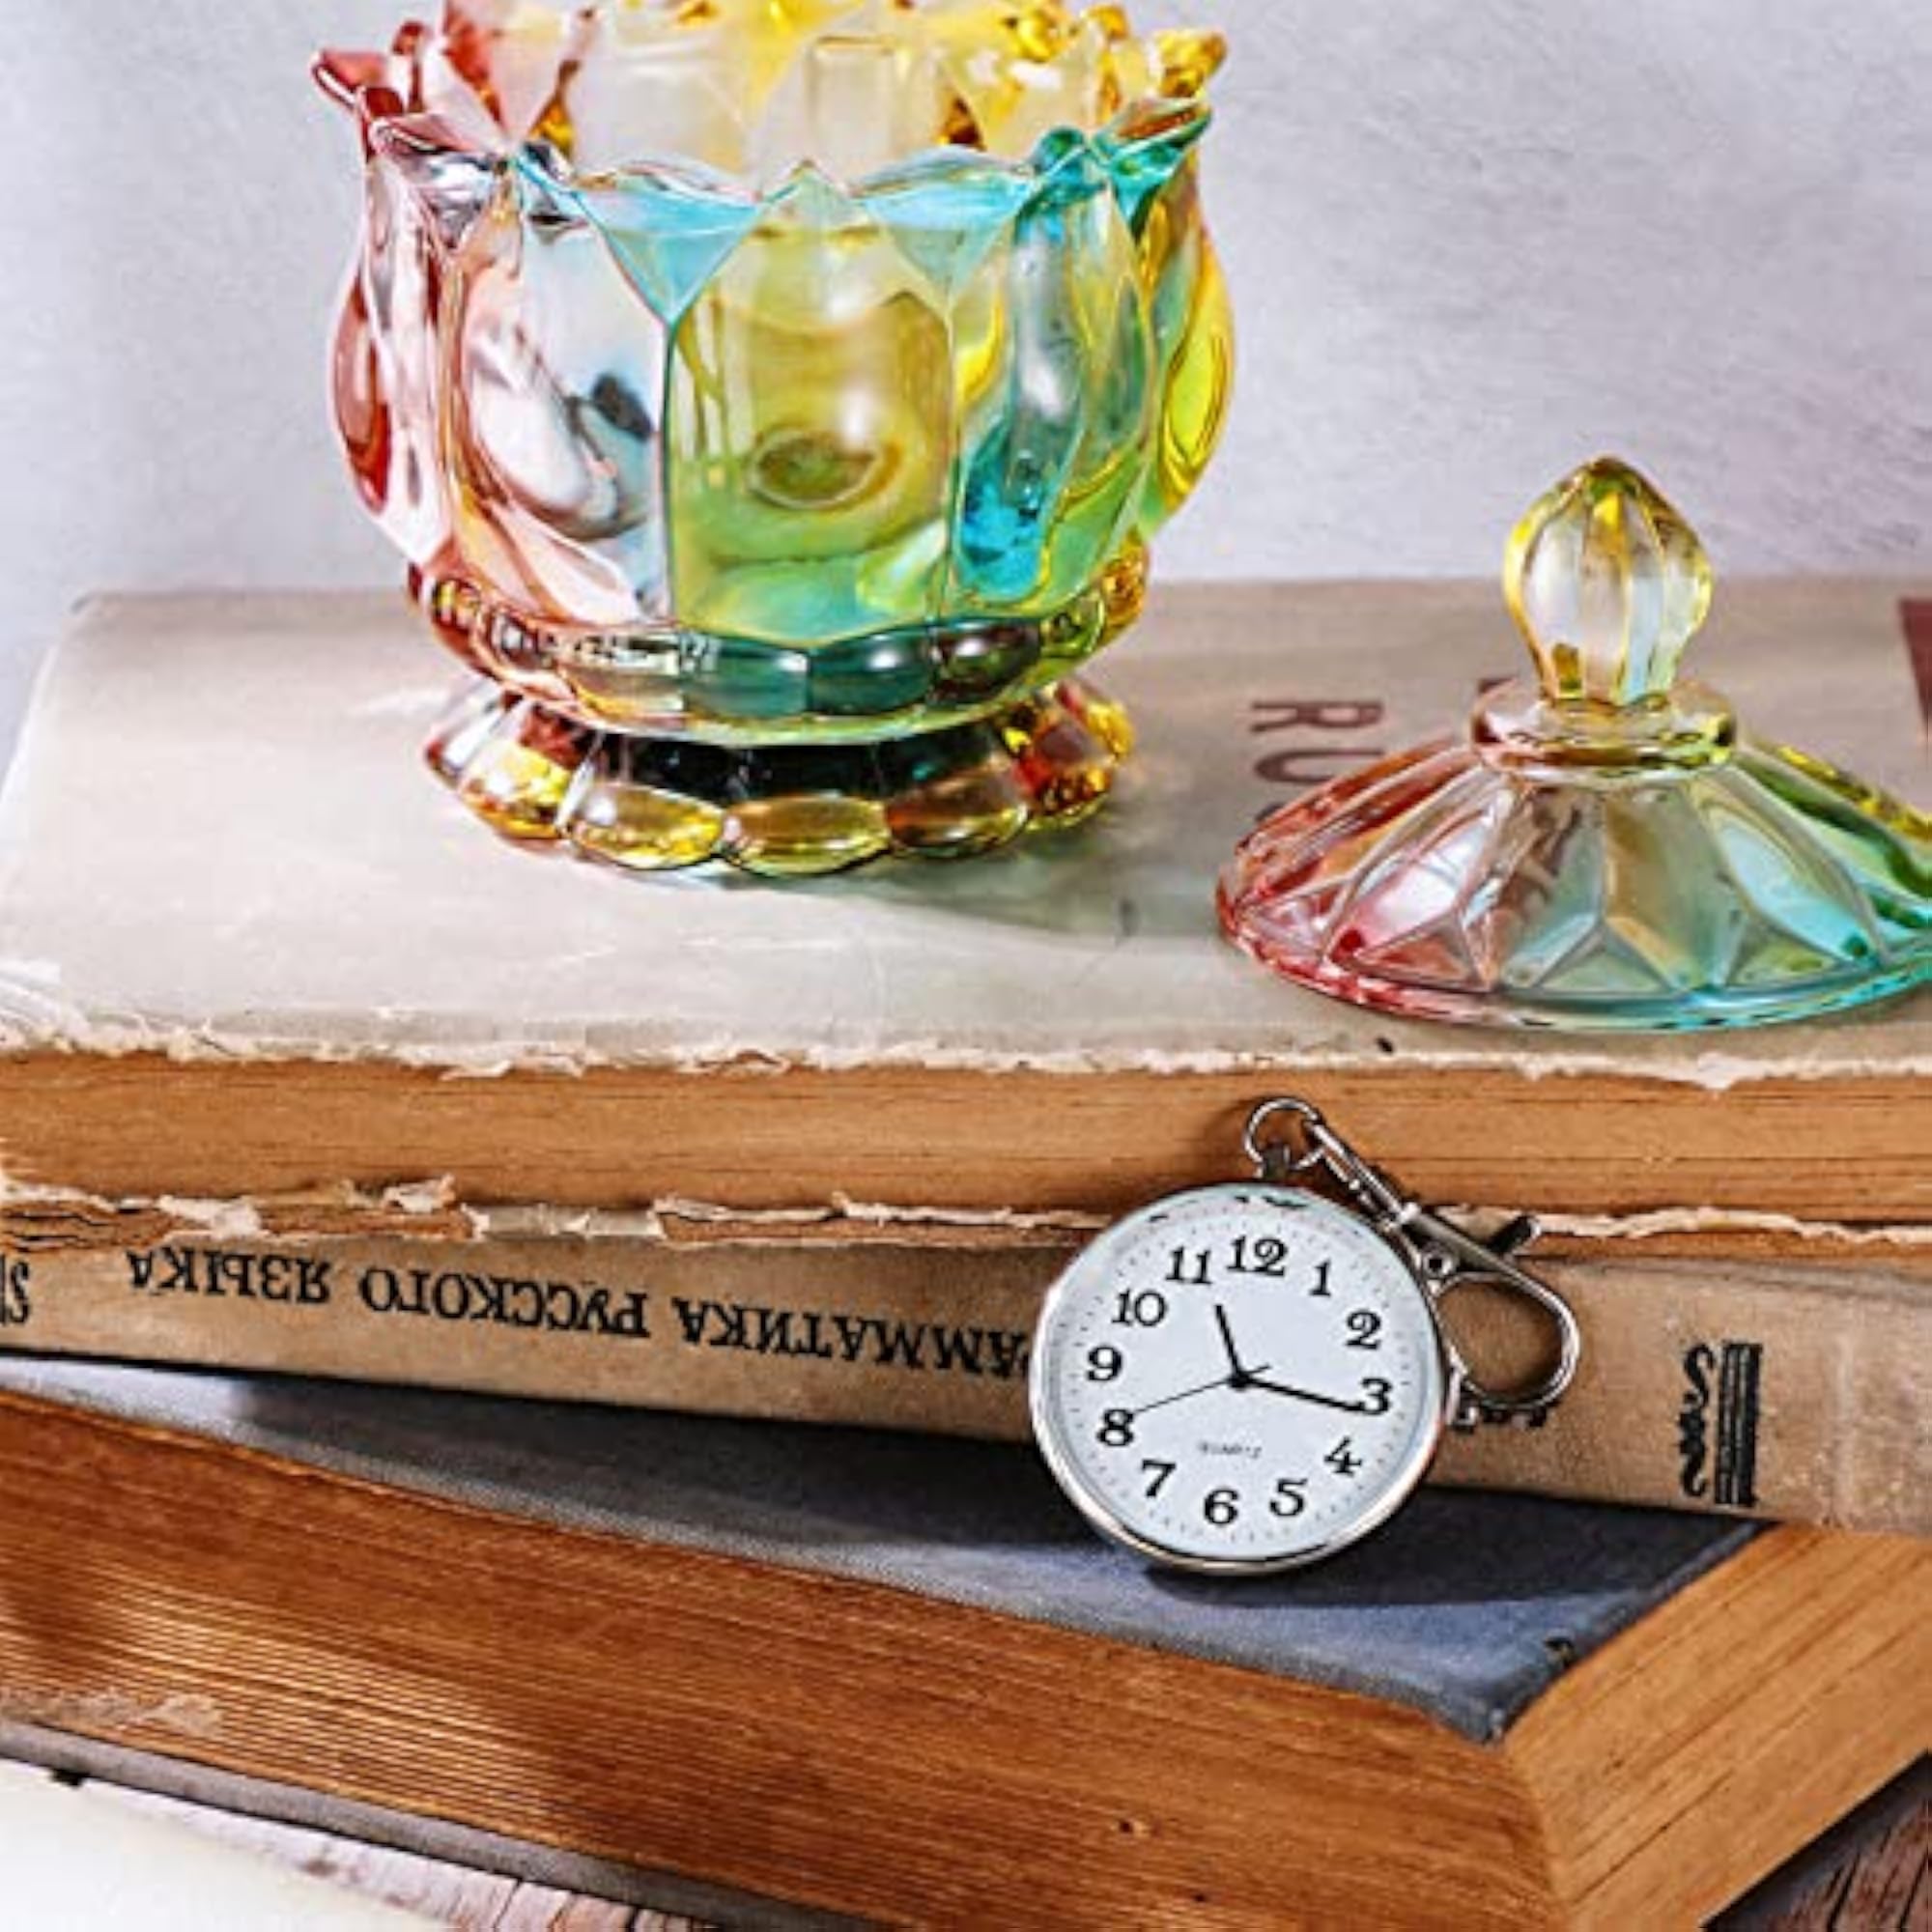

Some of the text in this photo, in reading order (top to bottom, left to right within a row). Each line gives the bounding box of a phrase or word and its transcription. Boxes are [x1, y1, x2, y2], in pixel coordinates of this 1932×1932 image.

[1166, 1245, 1212, 1285] 11
[1227, 1236, 1289, 1277] 12
[1309, 1261, 1331, 1296] 1
[126, 1245, 1030, 1379] АММАТИКА РУССКОГО ЯЗЫКА
[1112, 1289, 1168, 1326] 10
[1345, 1311, 1381, 1350] 2
[1086, 1347, 1122, 1382] 9
[1358, 1378, 1392, 1415] 3
[1096, 1408, 1134, 1446] 8
[1323, 1436, 1362, 1476] 4
[1141, 1459, 1177, 1497] 7
[1269, 1477, 1308, 1517] 5
[1204, 1489, 1239, 1525] 6
